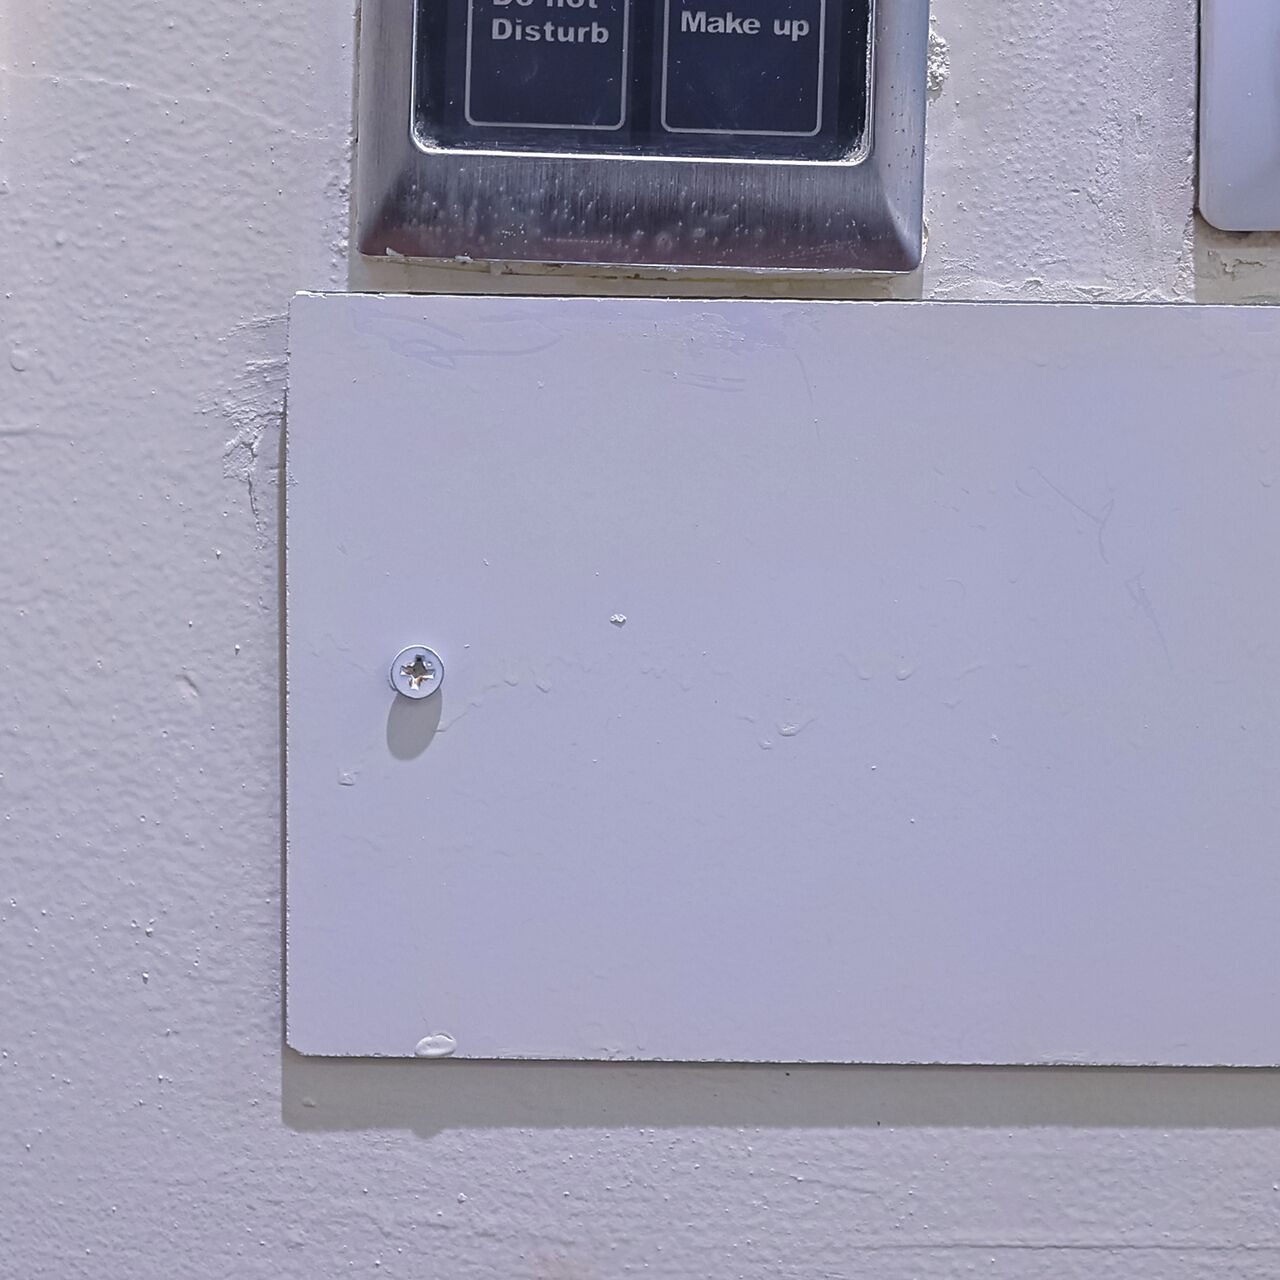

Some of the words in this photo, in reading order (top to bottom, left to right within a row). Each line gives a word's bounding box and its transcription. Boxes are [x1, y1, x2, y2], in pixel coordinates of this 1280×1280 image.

[491, 18, 609, 44] Disturb
[680, 10, 761, 35] Make
[773, 19, 810, 42] up
